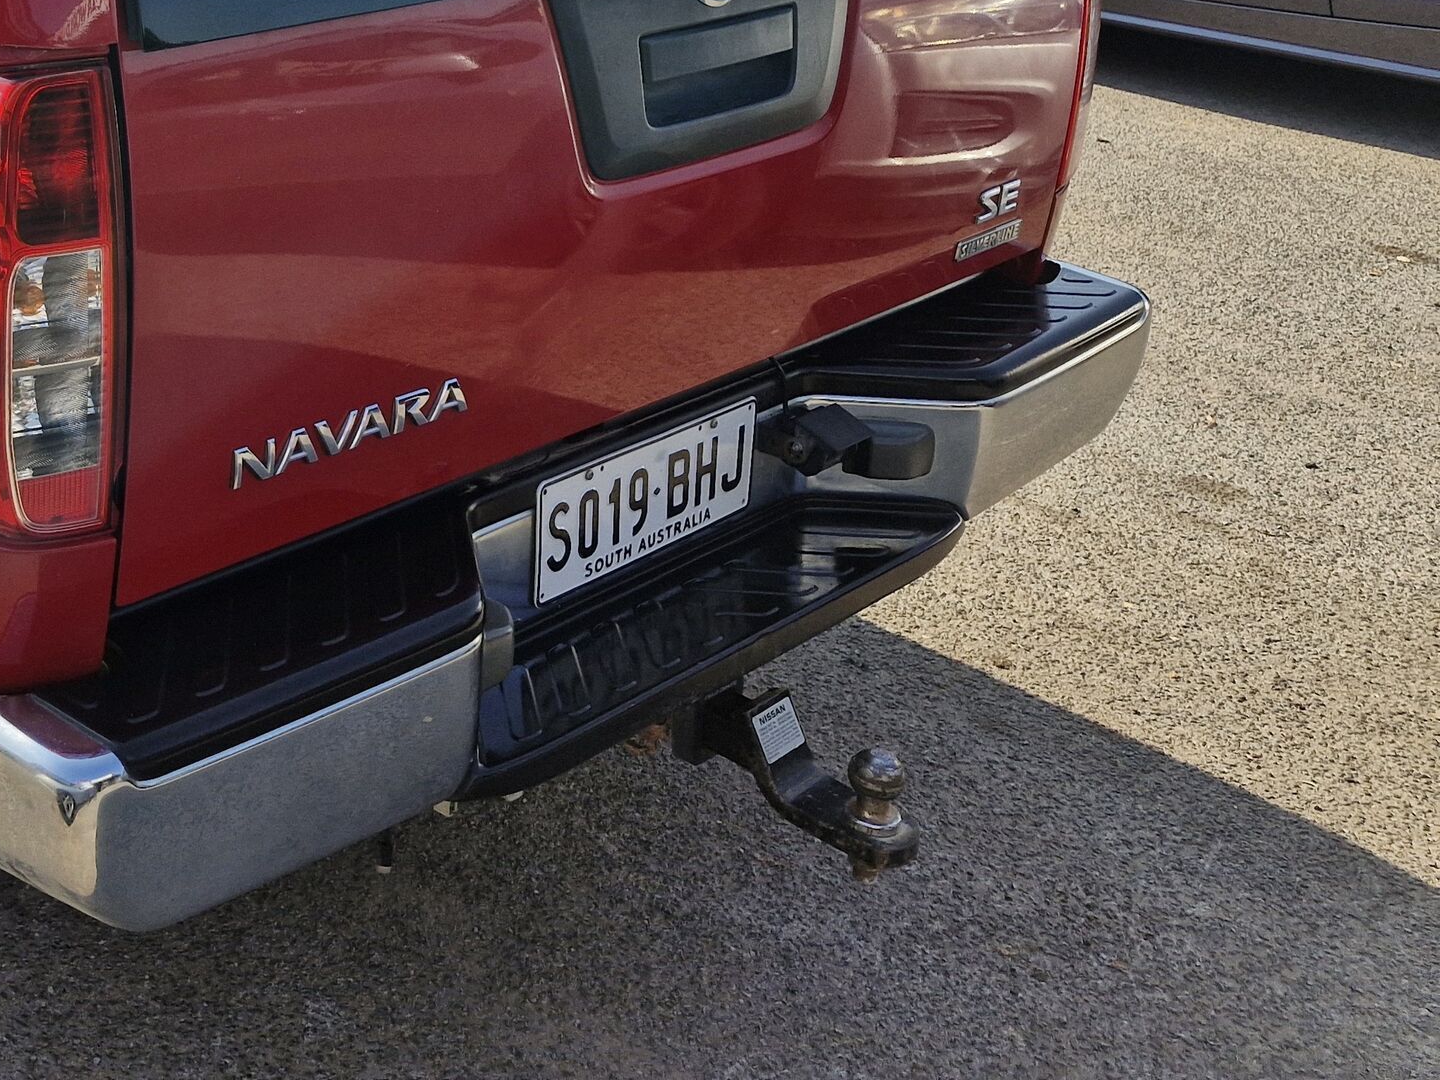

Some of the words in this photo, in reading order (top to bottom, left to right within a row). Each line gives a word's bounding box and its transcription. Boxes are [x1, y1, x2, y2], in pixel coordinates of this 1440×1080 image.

[976, 178, 1022, 225] SE
[959, 222, 1021, 259] SILVERLINE
[231, 376, 469, 491] NAVARA
[584, 543, 633, 578] SOUTH
[637, 507, 712, 554] AUSTRALIA
[758, 703, 787, 726] NISSAN
